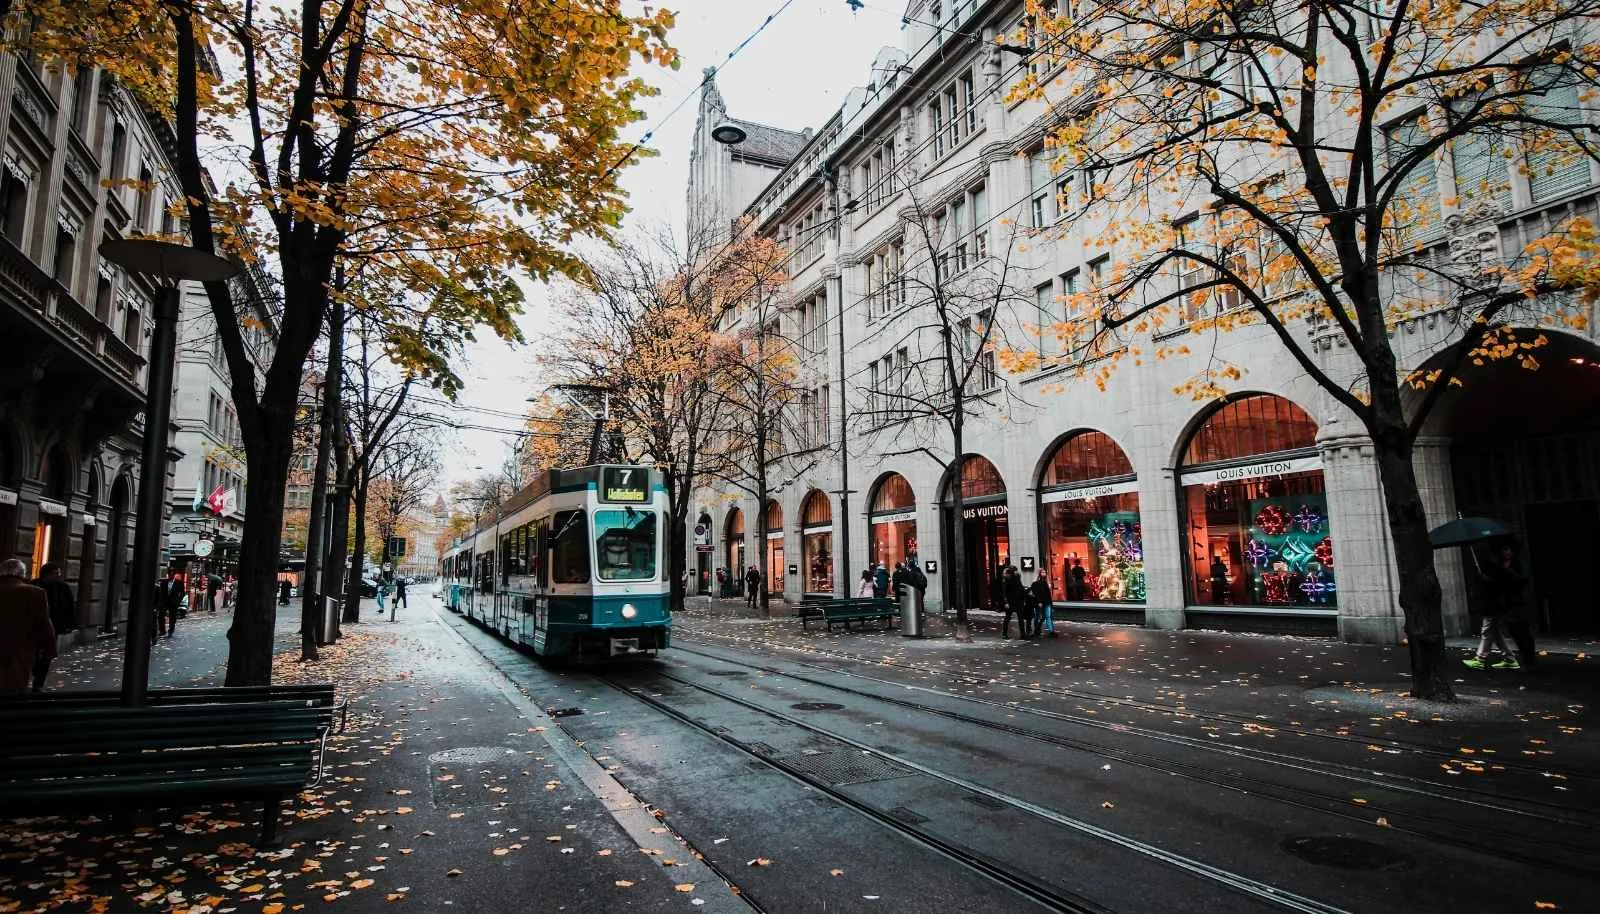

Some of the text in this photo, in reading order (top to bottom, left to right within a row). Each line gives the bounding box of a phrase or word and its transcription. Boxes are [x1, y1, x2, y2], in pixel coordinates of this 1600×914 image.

[620, 469, 633, 485] 7
[1216, 461, 1291, 480] LOUIS VUITTON
[1064, 486, 1113, 499] LOUIS VUITTON
[963, 508, 976, 519] UIS
